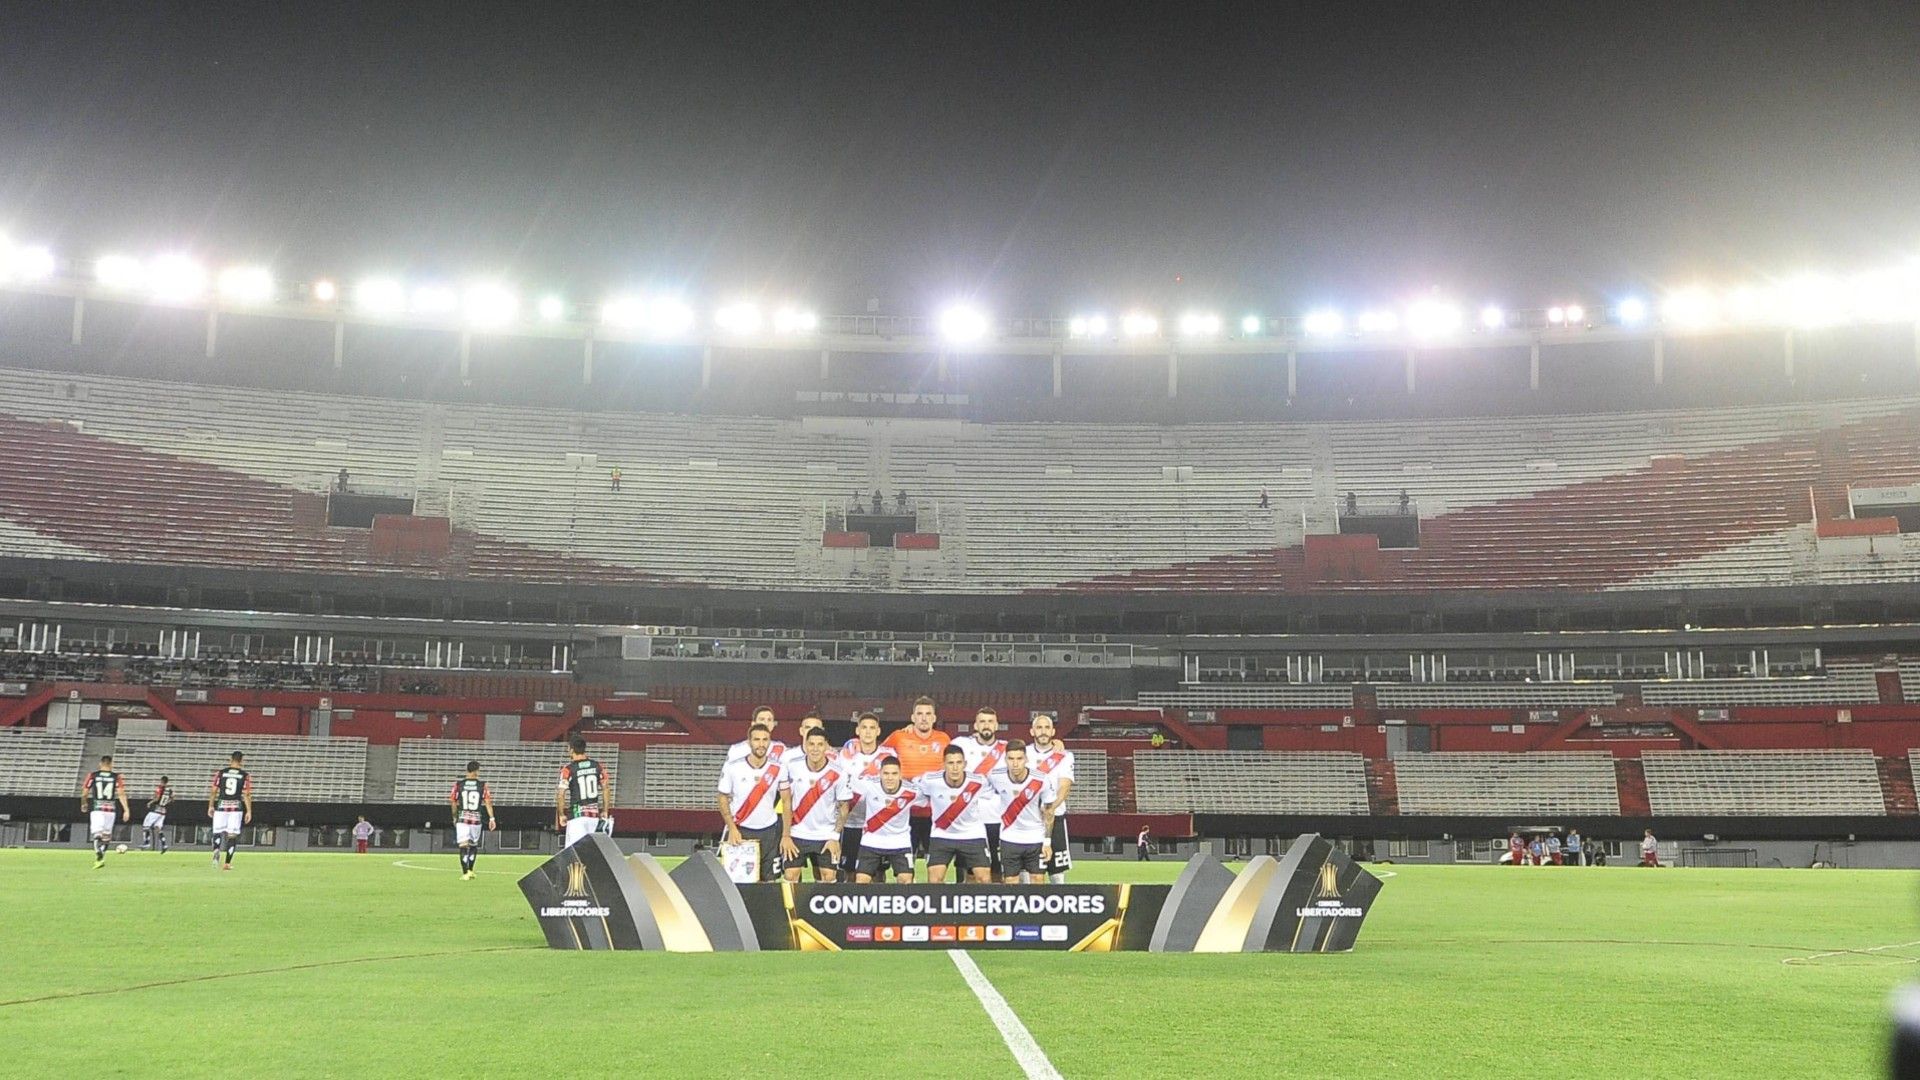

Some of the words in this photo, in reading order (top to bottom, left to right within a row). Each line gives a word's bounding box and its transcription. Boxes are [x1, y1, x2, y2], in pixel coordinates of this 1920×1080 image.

[70, 690, 79, 699] B
[320, 698, 328, 706] C
[1206, 711, 1216, 721] N
[1529, 711, 1540, 720] M
[1591, 714, 1599, 722] H
[1720, 709, 1728, 719] L
[95, 780, 115, 800] 14
[225, 777, 238, 796] 9
[577, 774, 598, 800] 10
[461, 790, 480, 811] 19
[1054, 850, 1069, 867] 22
[809, 894, 937, 914] CONMEBOL
[941, 894, 1105, 914] LIBERTADORES
[541, 907, 610, 917] LIBERTADORES
[1296, 907, 1363, 917] LIBERTADORES
[848, 929, 870, 937] QATAR
